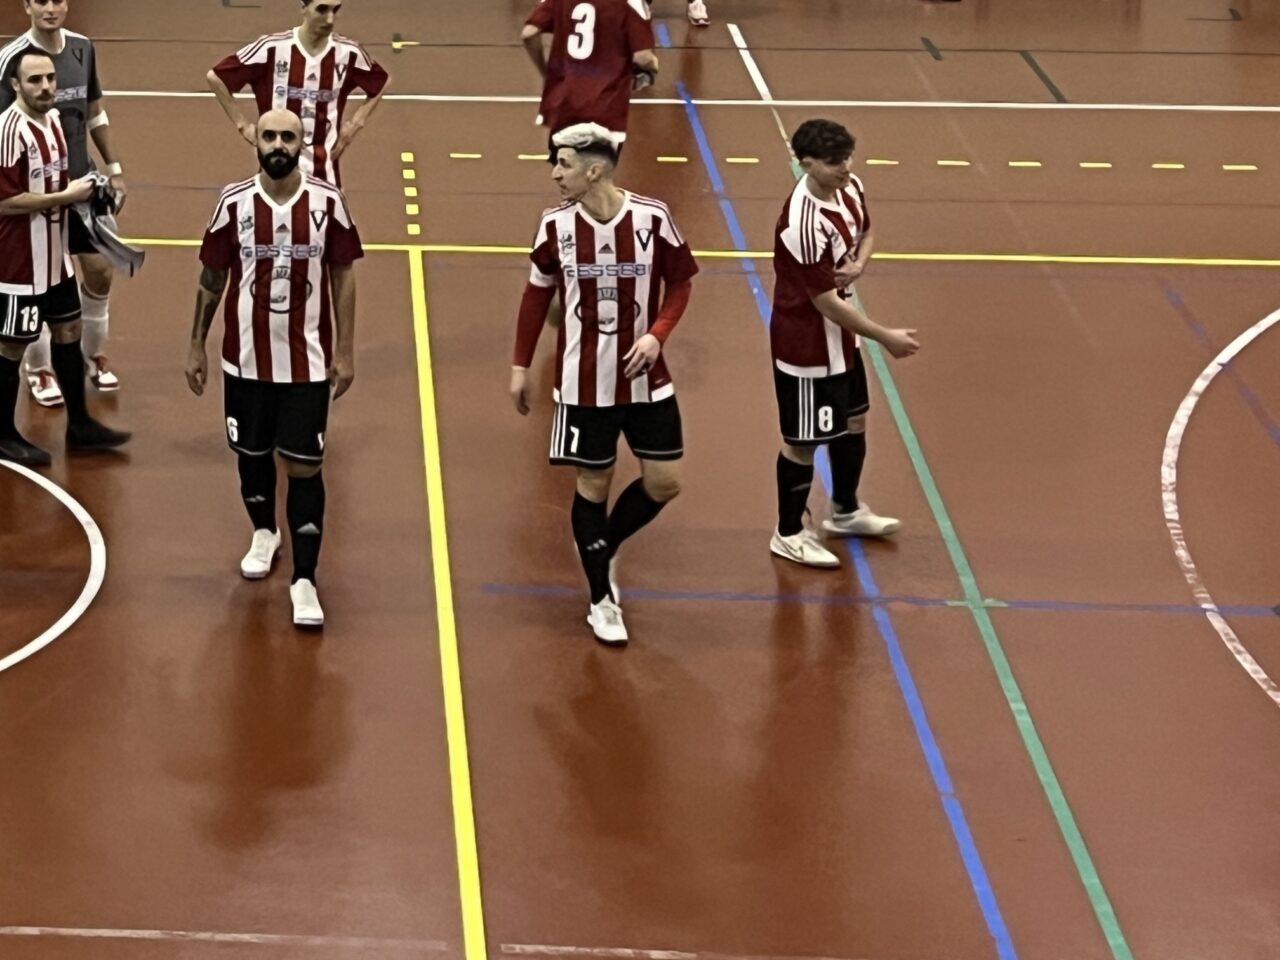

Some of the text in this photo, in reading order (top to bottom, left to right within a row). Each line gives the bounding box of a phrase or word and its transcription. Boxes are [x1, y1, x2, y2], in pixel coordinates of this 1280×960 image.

[566, 2, 596, 60] 3
[20, 305, 39, 332] 13
[226, 416, 239, 442] 6
[818, 405, 833, 433] 8
